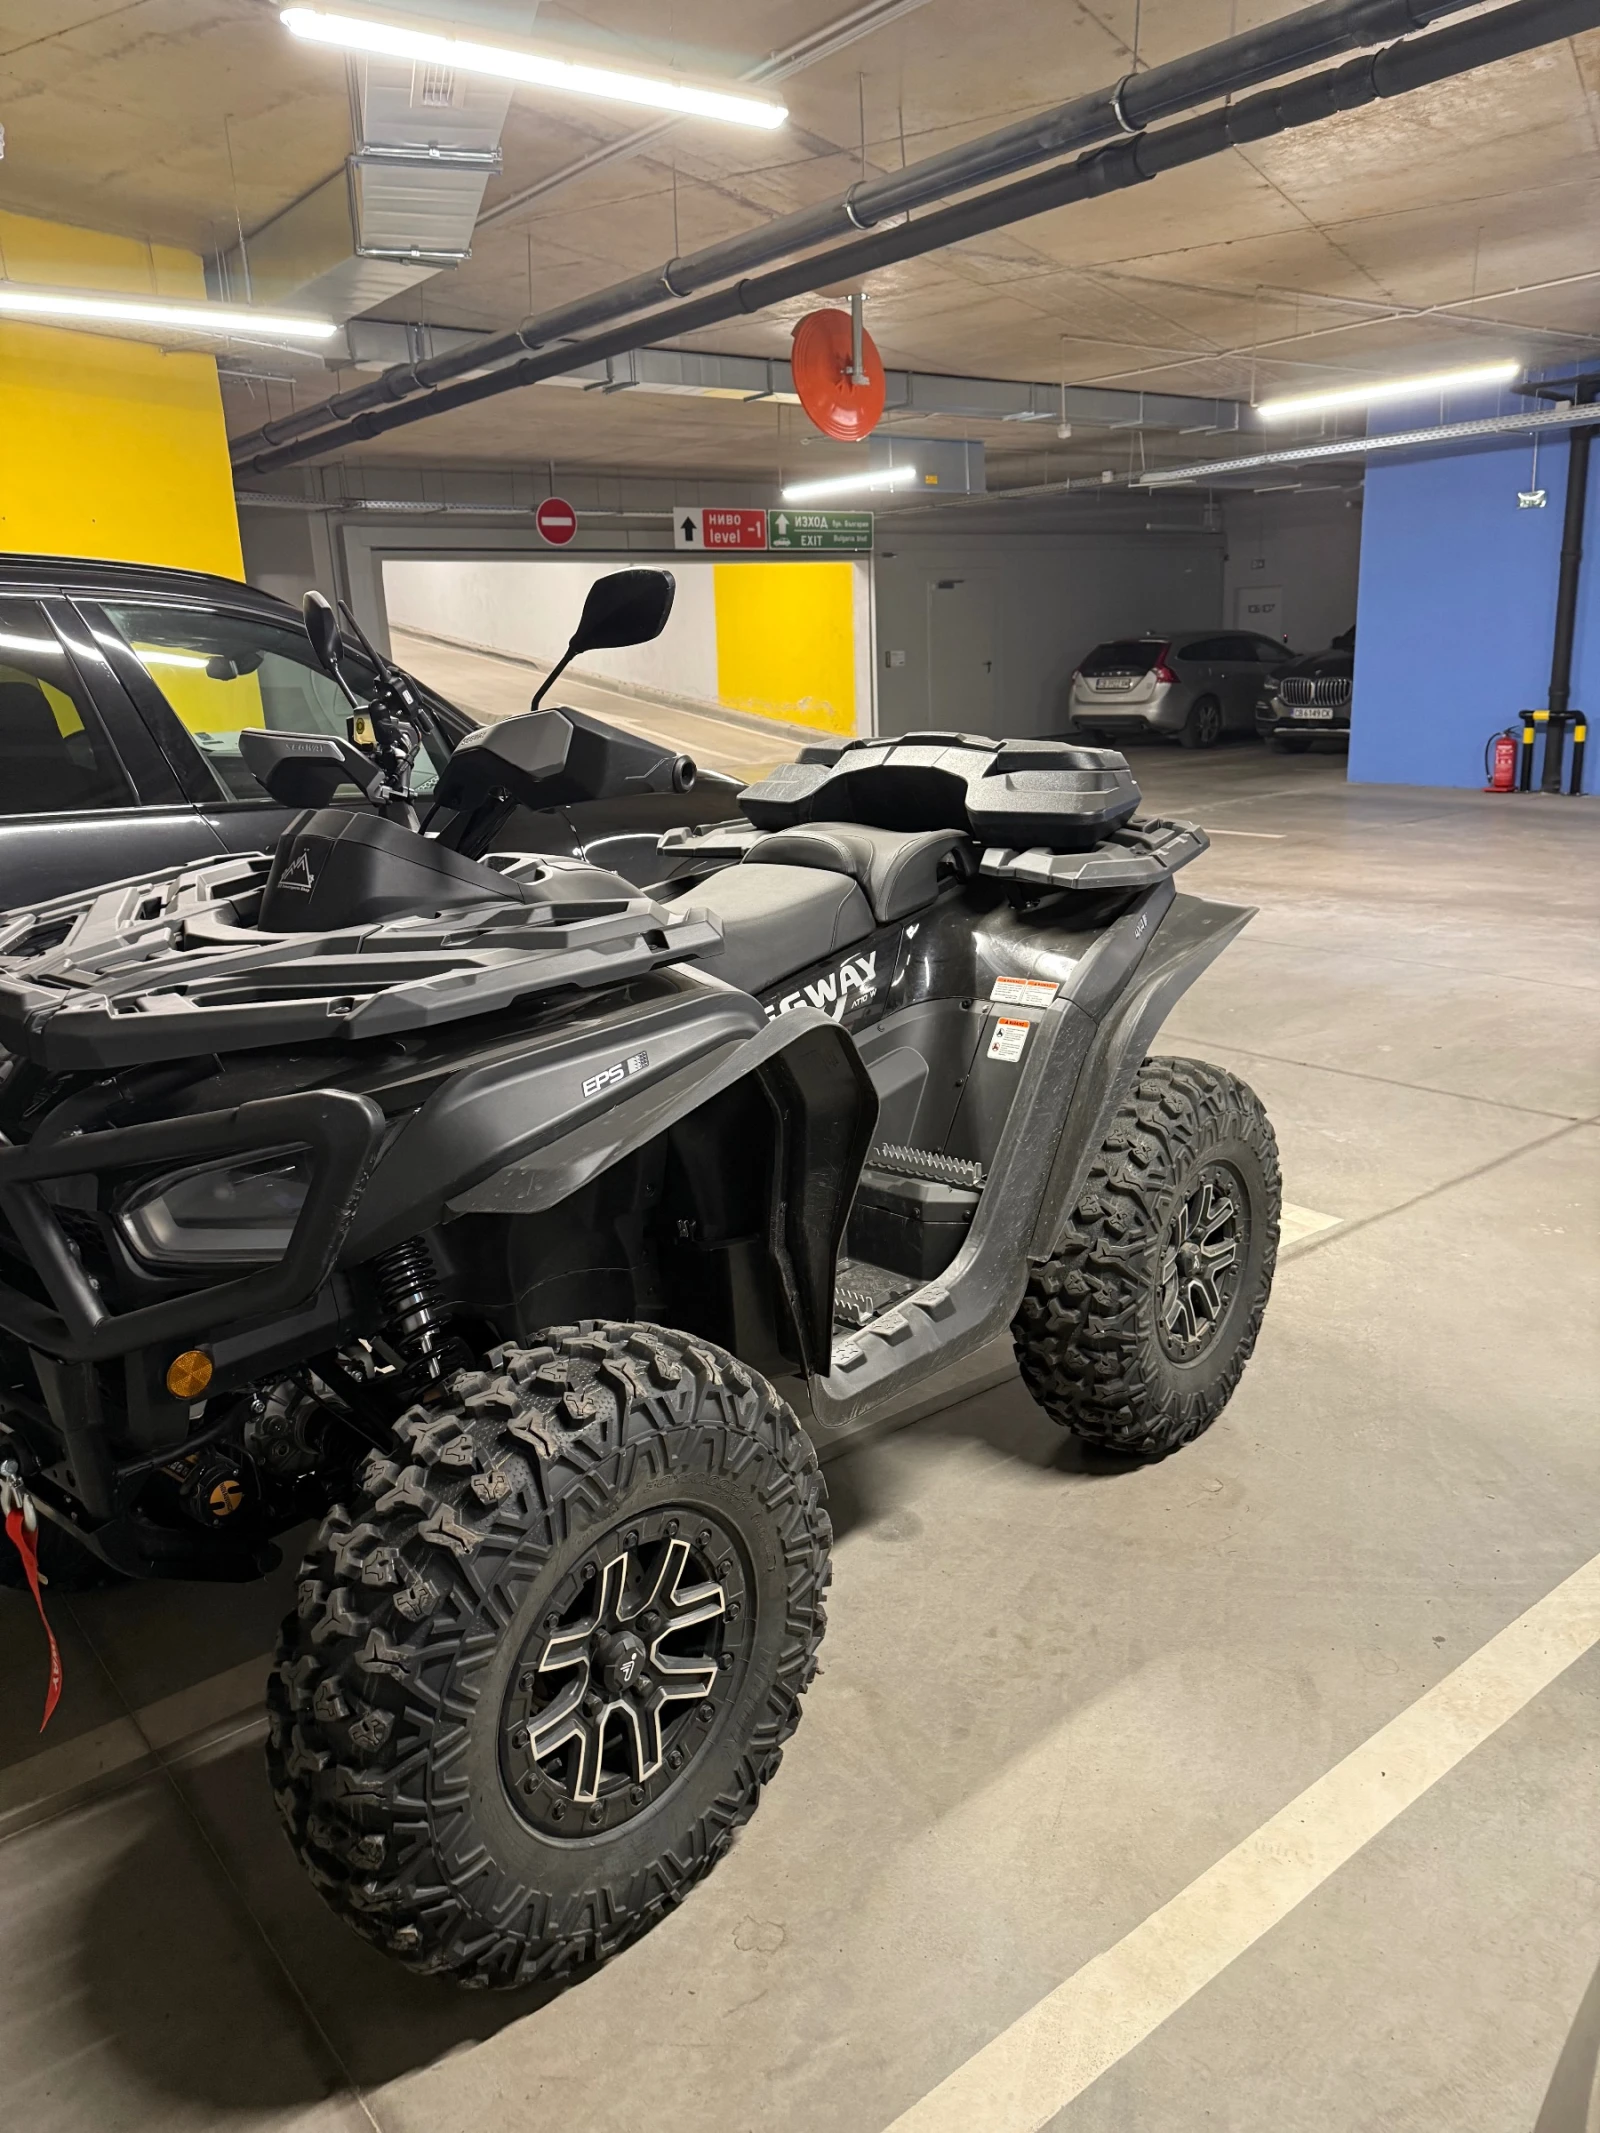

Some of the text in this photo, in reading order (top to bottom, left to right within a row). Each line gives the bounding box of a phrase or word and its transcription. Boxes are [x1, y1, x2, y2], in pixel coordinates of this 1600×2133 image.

[747, 520, 762, 539] -1
[794, 515, 829, 530] ИЗХОД
[709, 529, 741, 544] level
[800, 534, 824, 547] EXIT
[764, 951, 877, 1021] GWAY
[582, 1063, 625, 1098] EPS
